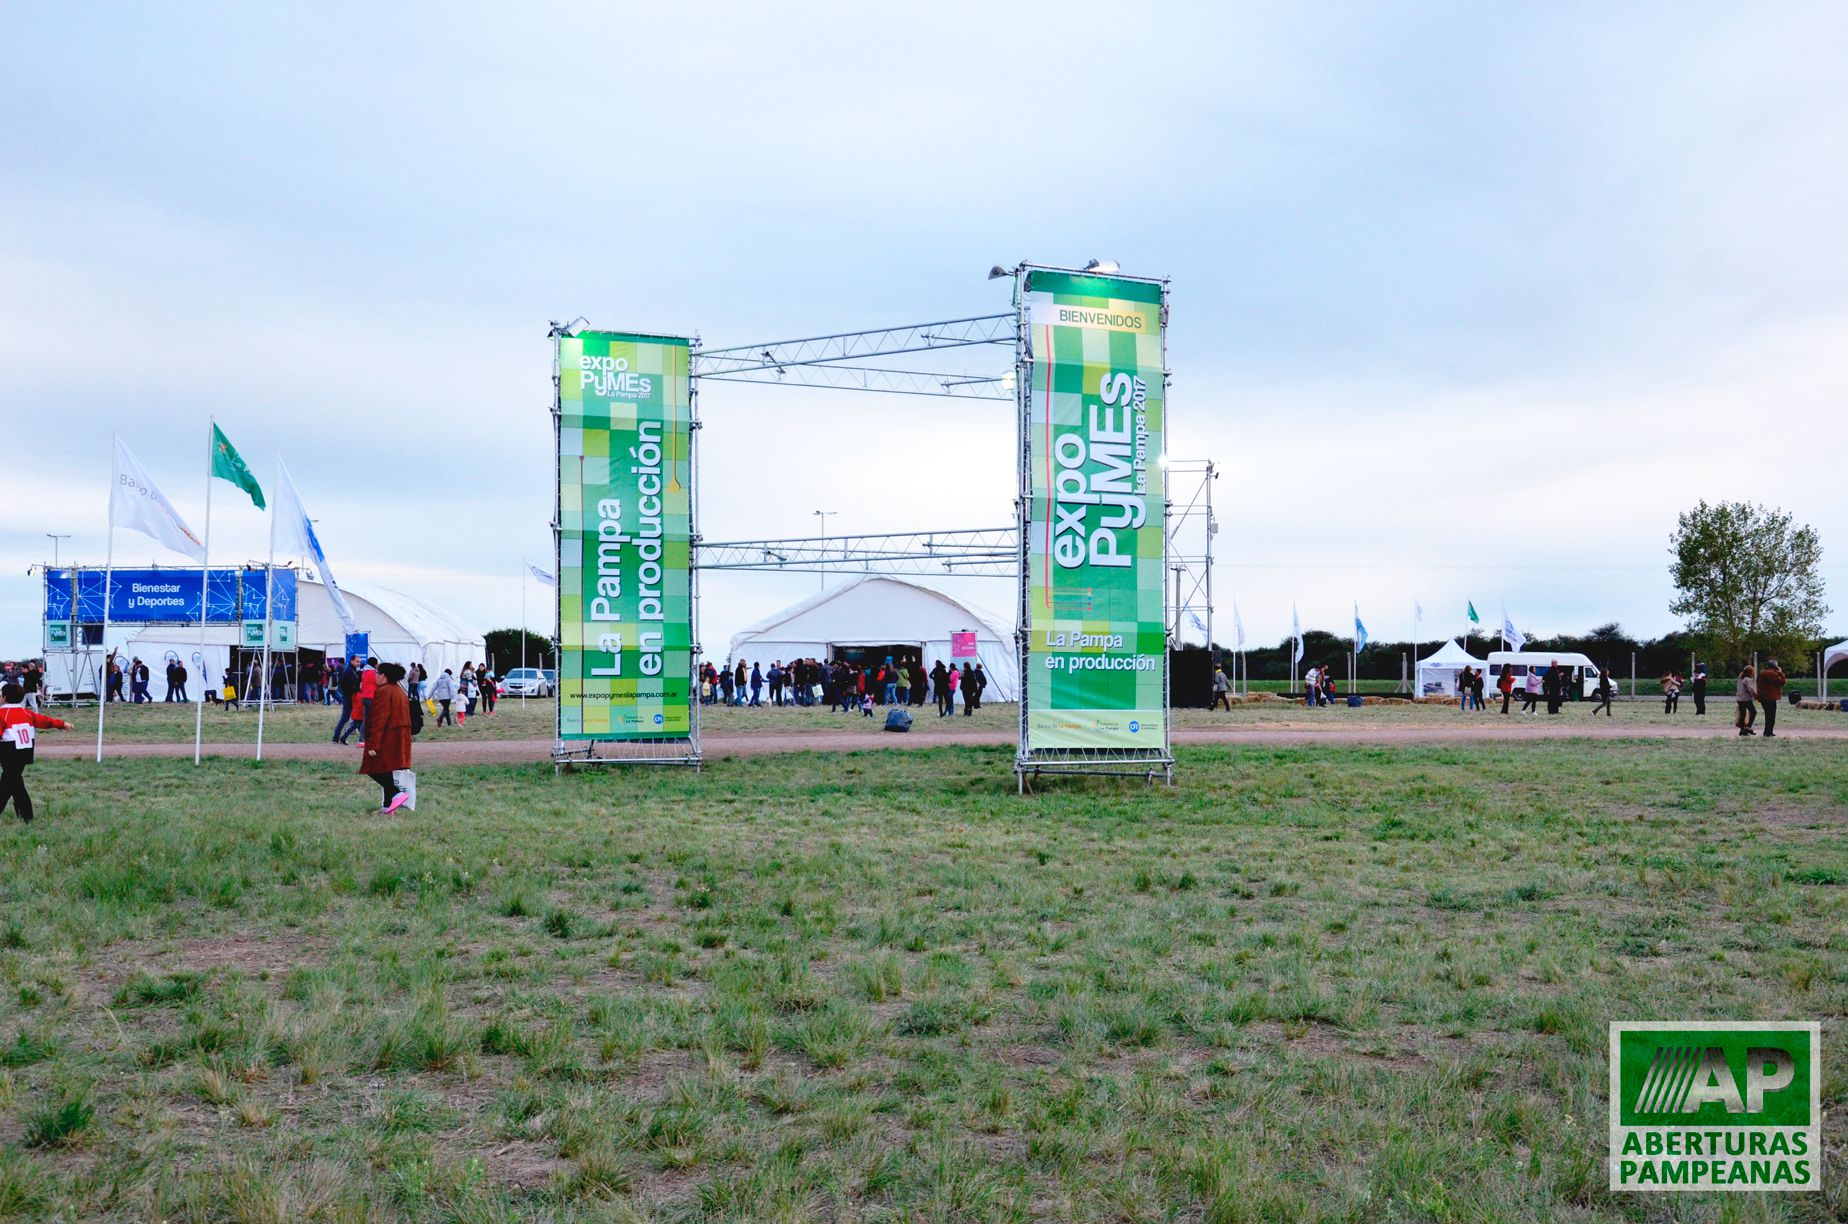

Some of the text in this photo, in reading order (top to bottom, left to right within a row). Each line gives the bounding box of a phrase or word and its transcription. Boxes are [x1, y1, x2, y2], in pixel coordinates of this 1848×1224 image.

[1059, 308, 1142, 329] BIENVENIDOS
[578, 355, 628, 376] expo
[580, 370, 652, 397] PyMEs
[616, 391, 637, 400] Pampa
[1133, 375, 1149, 496] La Pampa 2017
[1054, 433, 1102, 569] expo
[629, 421, 664, 676] en producción
[132, 583, 180, 593] Bienestar
[591, 498, 632, 676] La Pampa
[128, 596, 185, 608] y Deportes
[1046, 630, 1124, 652] La Pampa
[1045, 653, 1156, 674] en producción
[17, 728, 29, 745] 10
